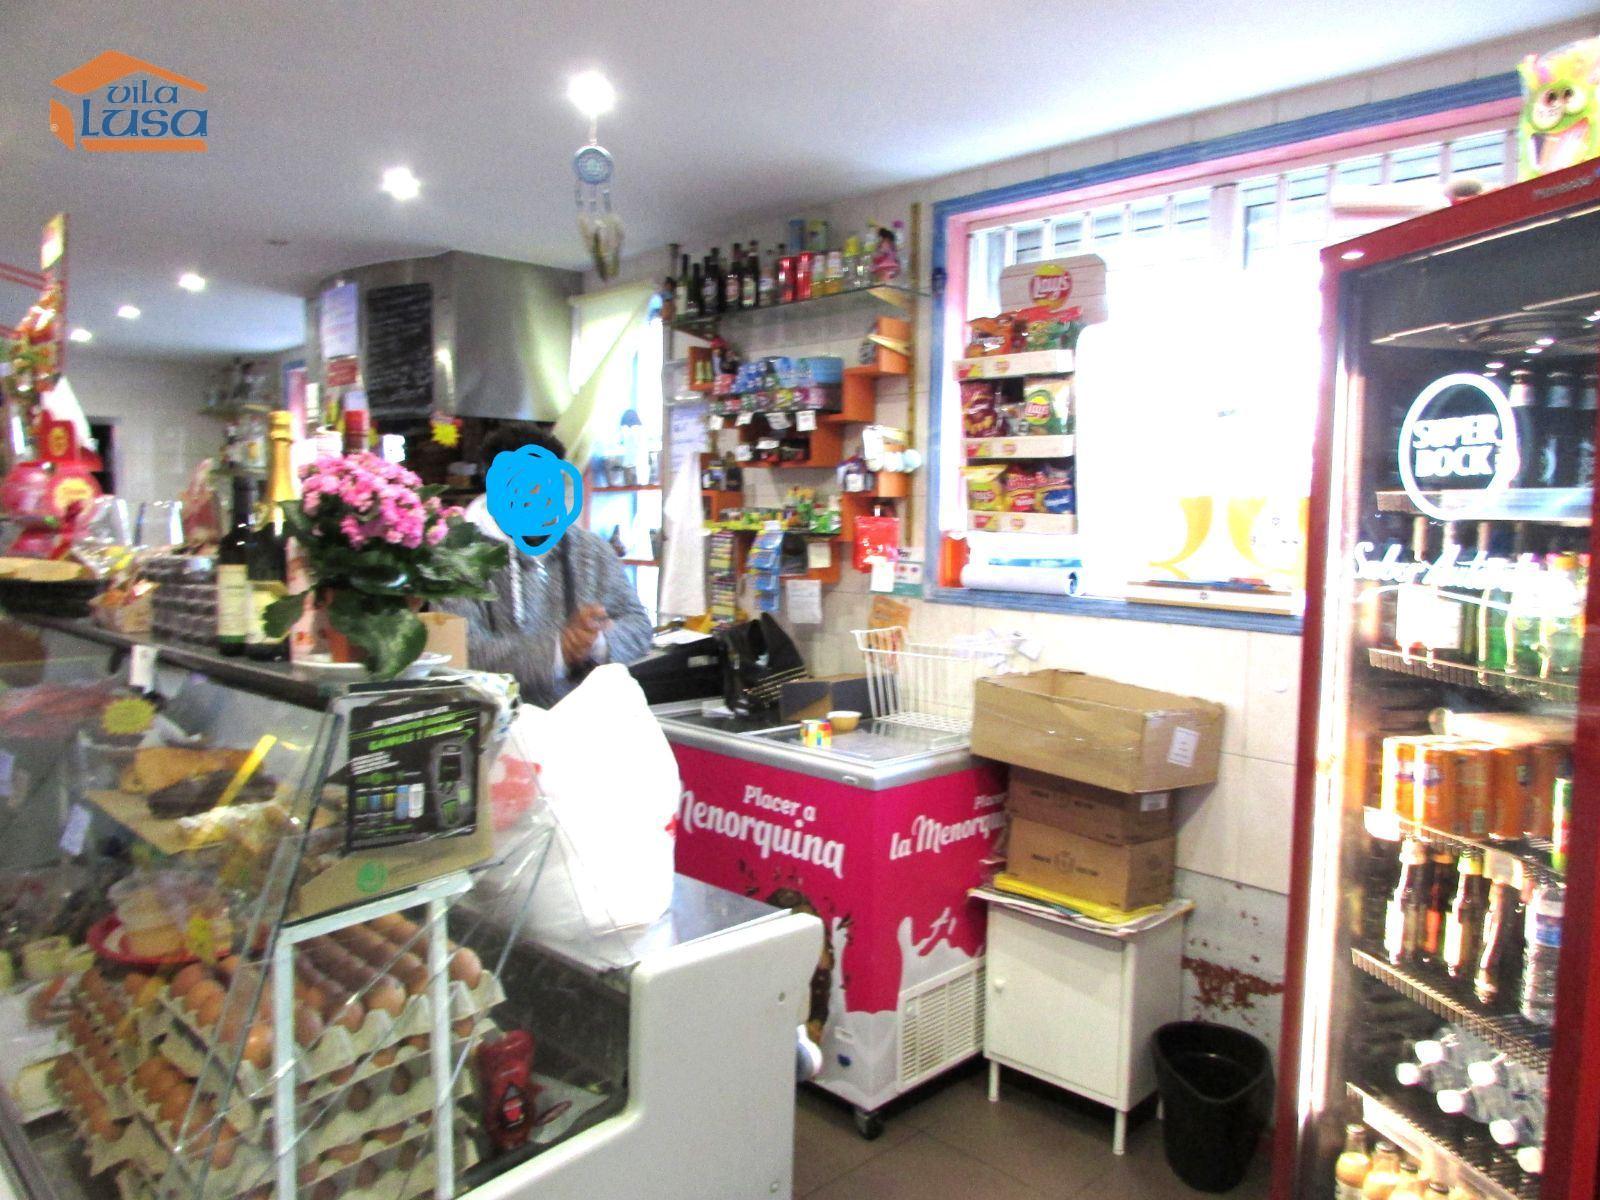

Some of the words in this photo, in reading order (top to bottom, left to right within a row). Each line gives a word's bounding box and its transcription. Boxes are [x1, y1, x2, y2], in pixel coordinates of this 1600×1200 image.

[1412, 413, 1500, 449] SUPER
[1415, 445, 1497, 477] BOCK
[742, 784, 801, 817] Placer
[802, 805, 817, 822] a
[889, 832, 912, 861] la
